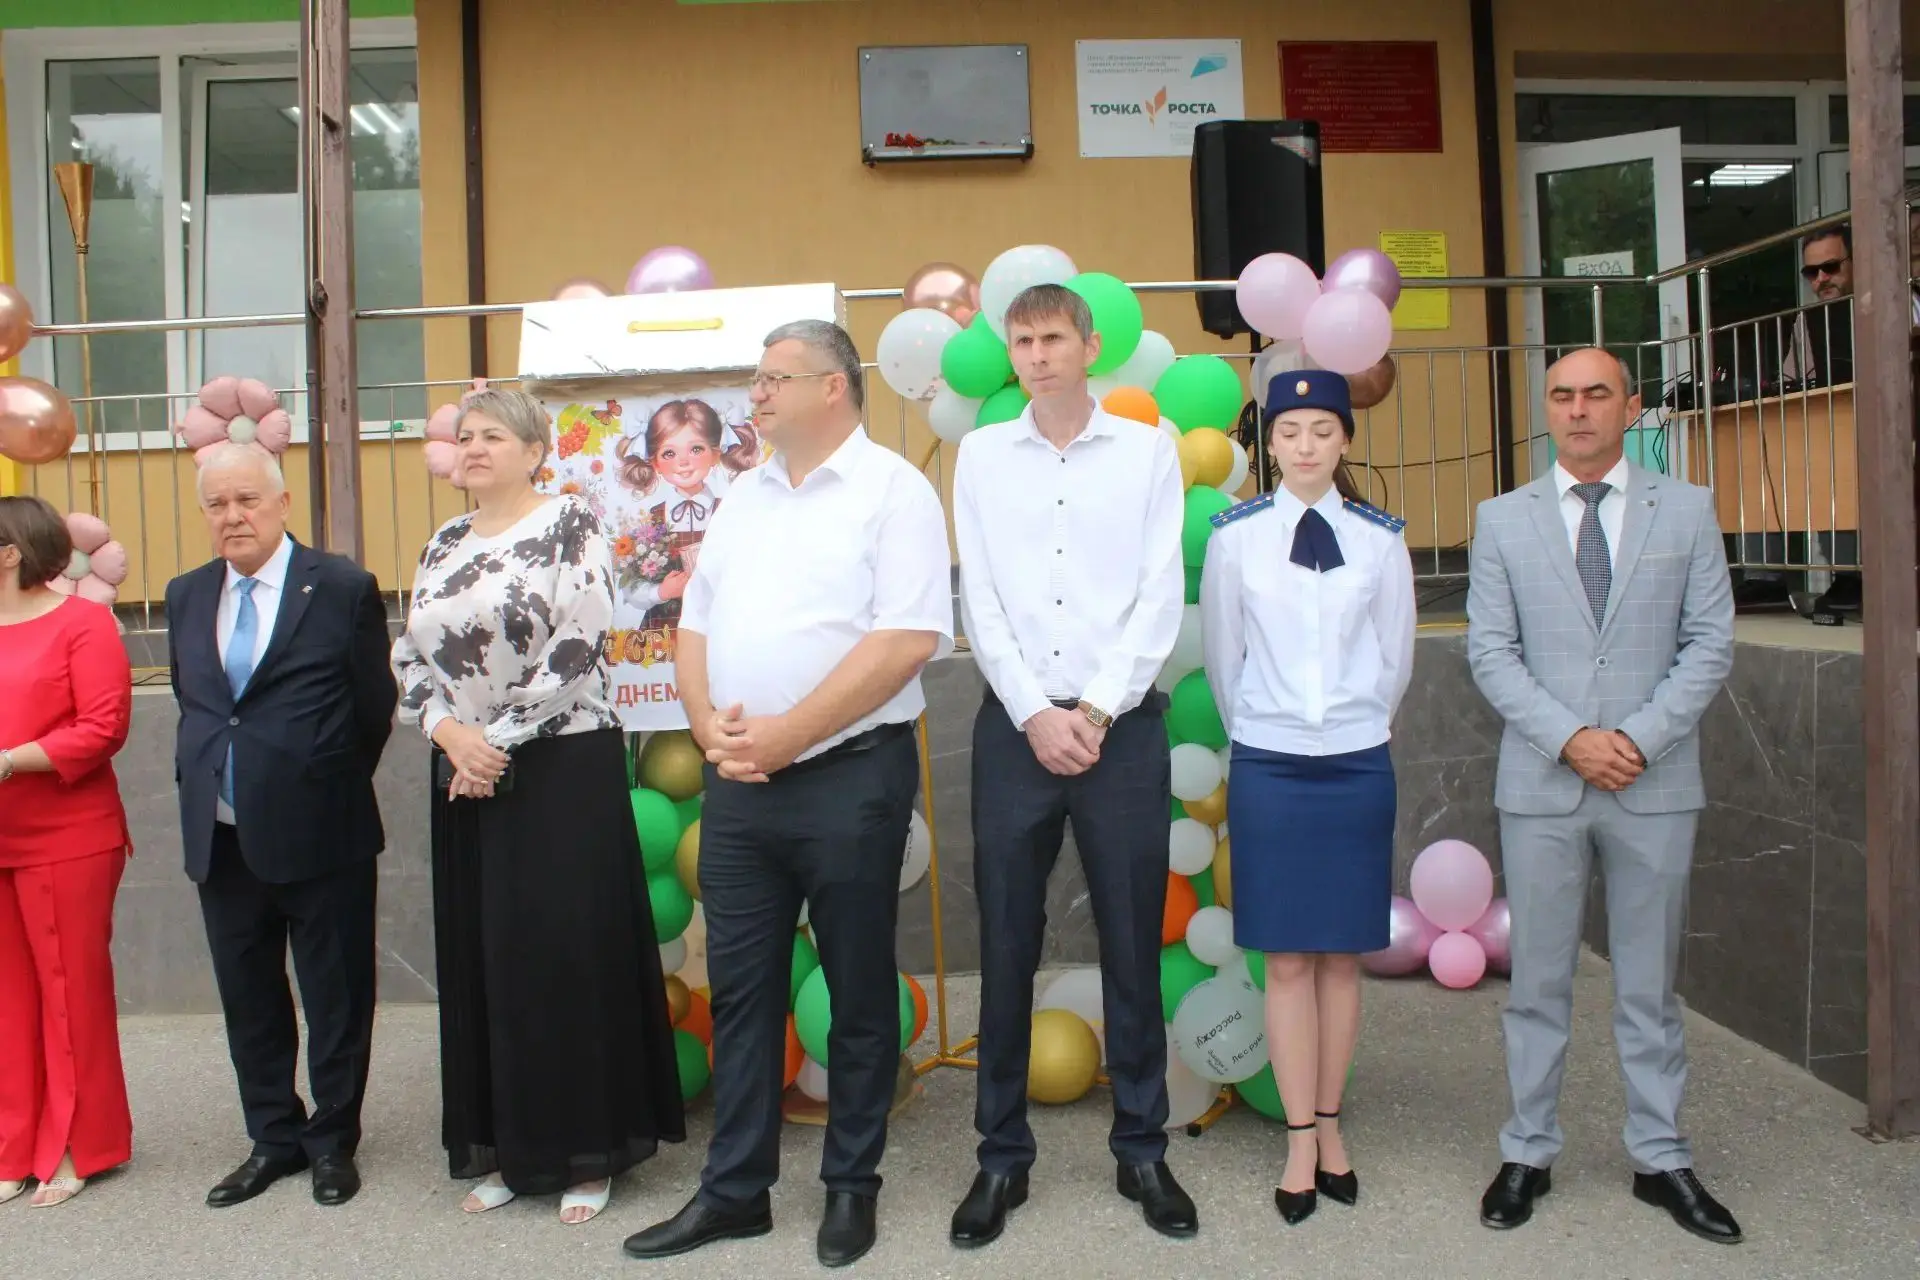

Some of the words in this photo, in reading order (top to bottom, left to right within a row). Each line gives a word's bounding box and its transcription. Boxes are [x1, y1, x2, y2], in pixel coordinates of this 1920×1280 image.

[1090, 103, 1142, 115] ТОЧКА
[1168, 103, 1217, 114] РОСТА
[615, 682, 680, 708] ДНЕМ
